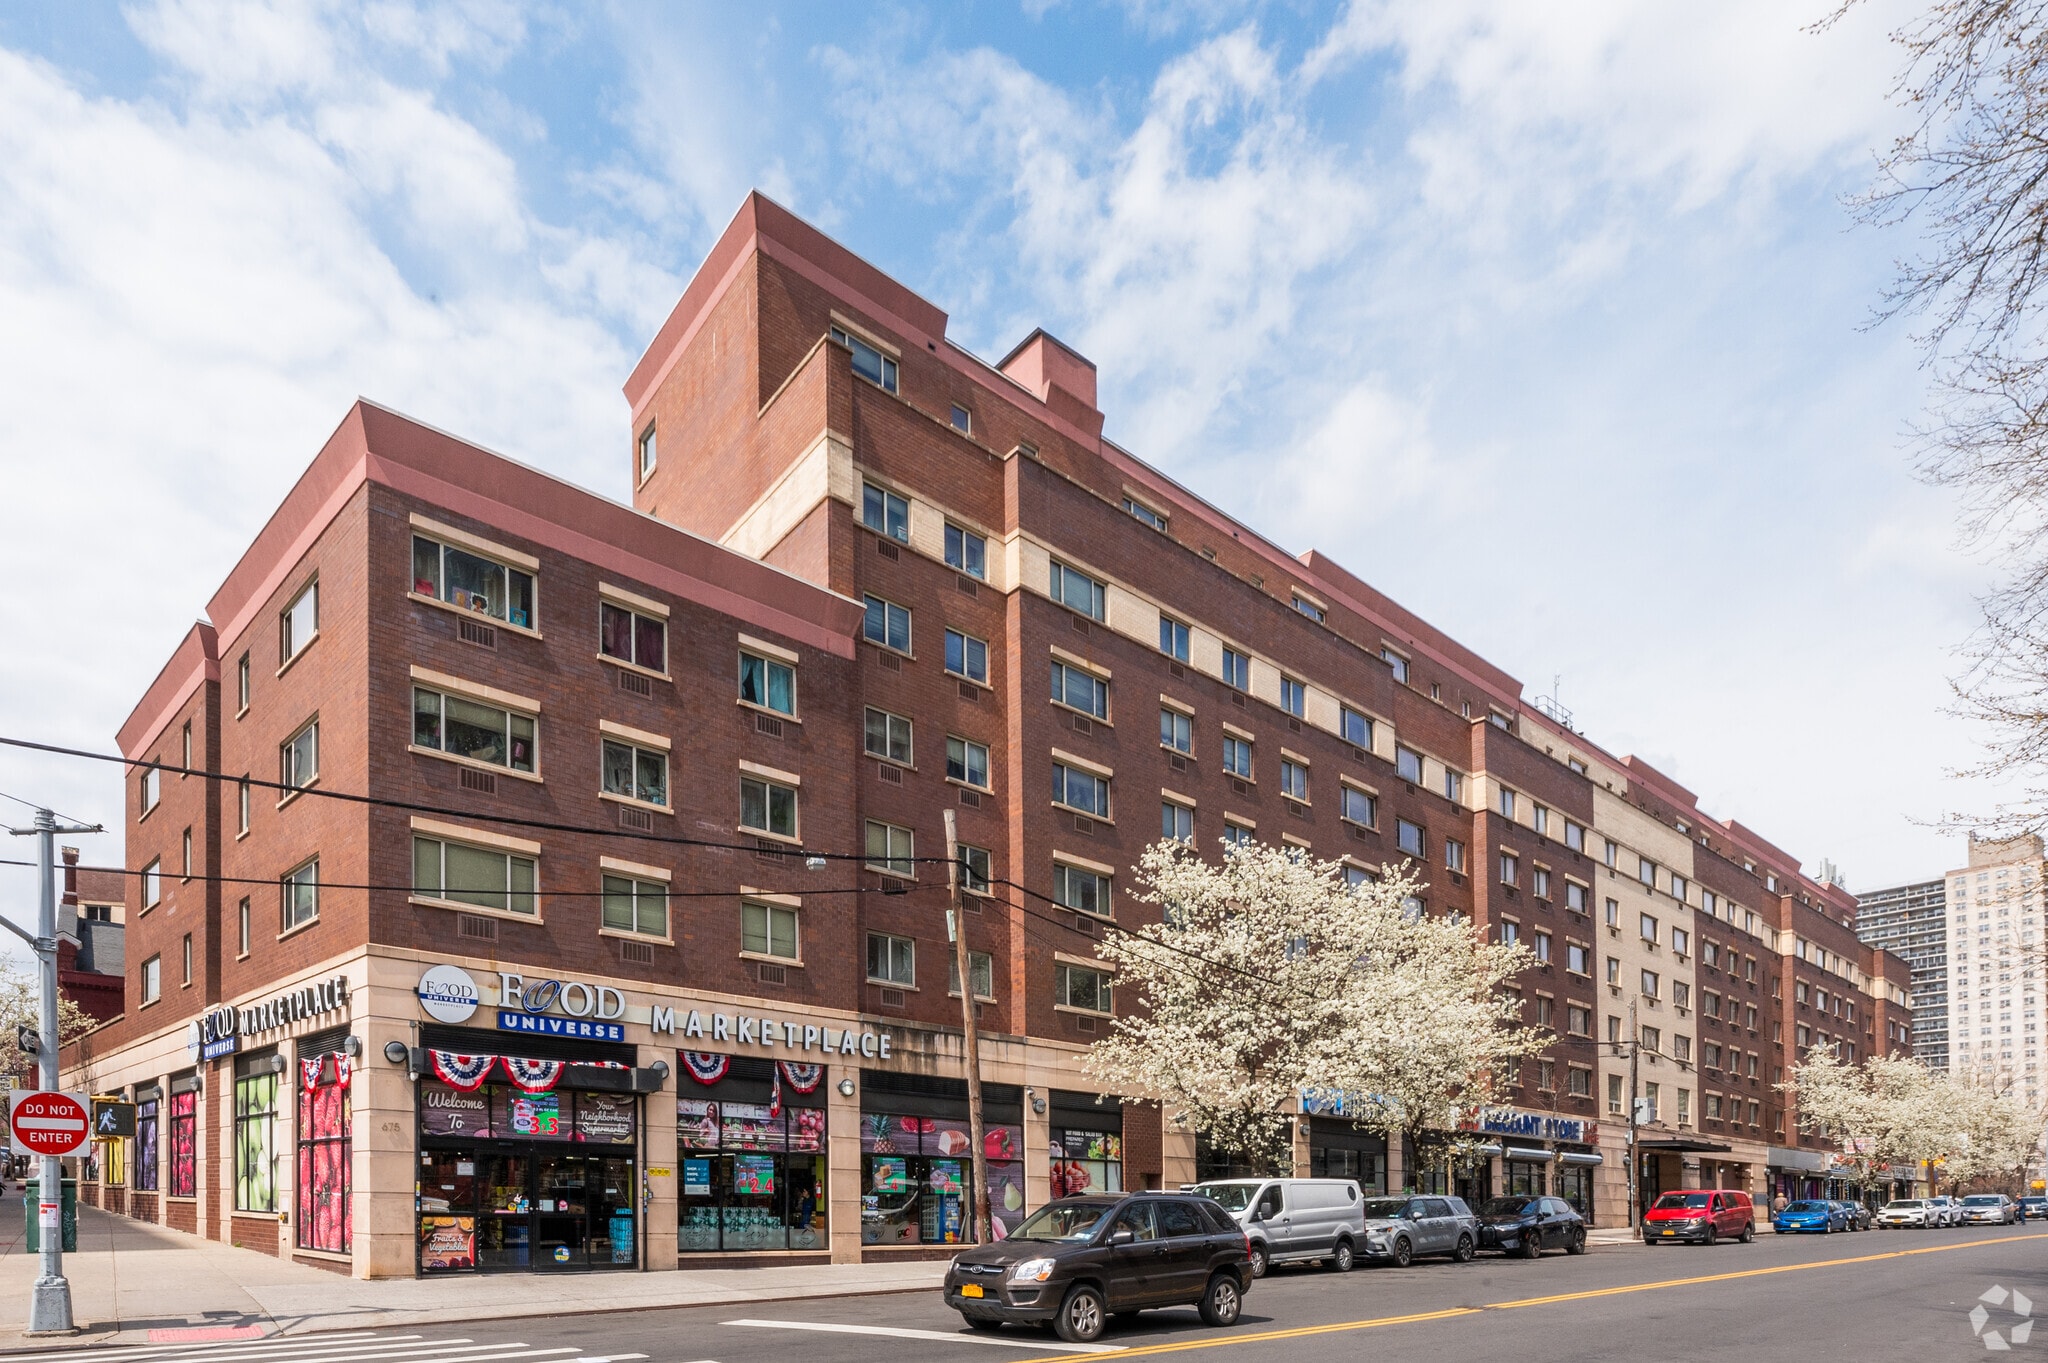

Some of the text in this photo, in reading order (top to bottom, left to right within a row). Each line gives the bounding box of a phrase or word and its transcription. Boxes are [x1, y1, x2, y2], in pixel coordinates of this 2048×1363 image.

[425, 980, 473, 998] FOOD
[499, 972, 626, 1019] FOOD
[241, 975, 343, 1036] MARKETPLACE
[427, 994, 470, 1004] UNIVERSE
[203, 1005, 234, 1043] FOOD
[504, 1014, 619, 1039] UNIVERSE
[652, 1005, 892, 1059] MARKETPLACE
[204, 1039, 234, 1057] UNIVERSE
[428, 1091, 485, 1109] Welcome
[596, 1100, 615, 1110] Your
[25, 1104, 75, 1116] DO NOT
[580, 1110, 631, 1125] Neighborhood
[381, 1122, 401, 1131] 675
[448, 1113, 465, 1129] To
[529, 1116, 540, 1135] 3
[547, 1117, 559, 1136] 3
[582, 1122, 629, 1136] Supermarket
[1485, 1109, 1541, 1136] DISCOUNT
[1544, 1118, 1580, 1140] STORE
[29, 1132, 73, 1143] ENTER
[765, 1178, 774, 1193] 4
[431, 1233, 464, 1243] Fruits &
[429, 1241, 468, 1255] Vegetables
